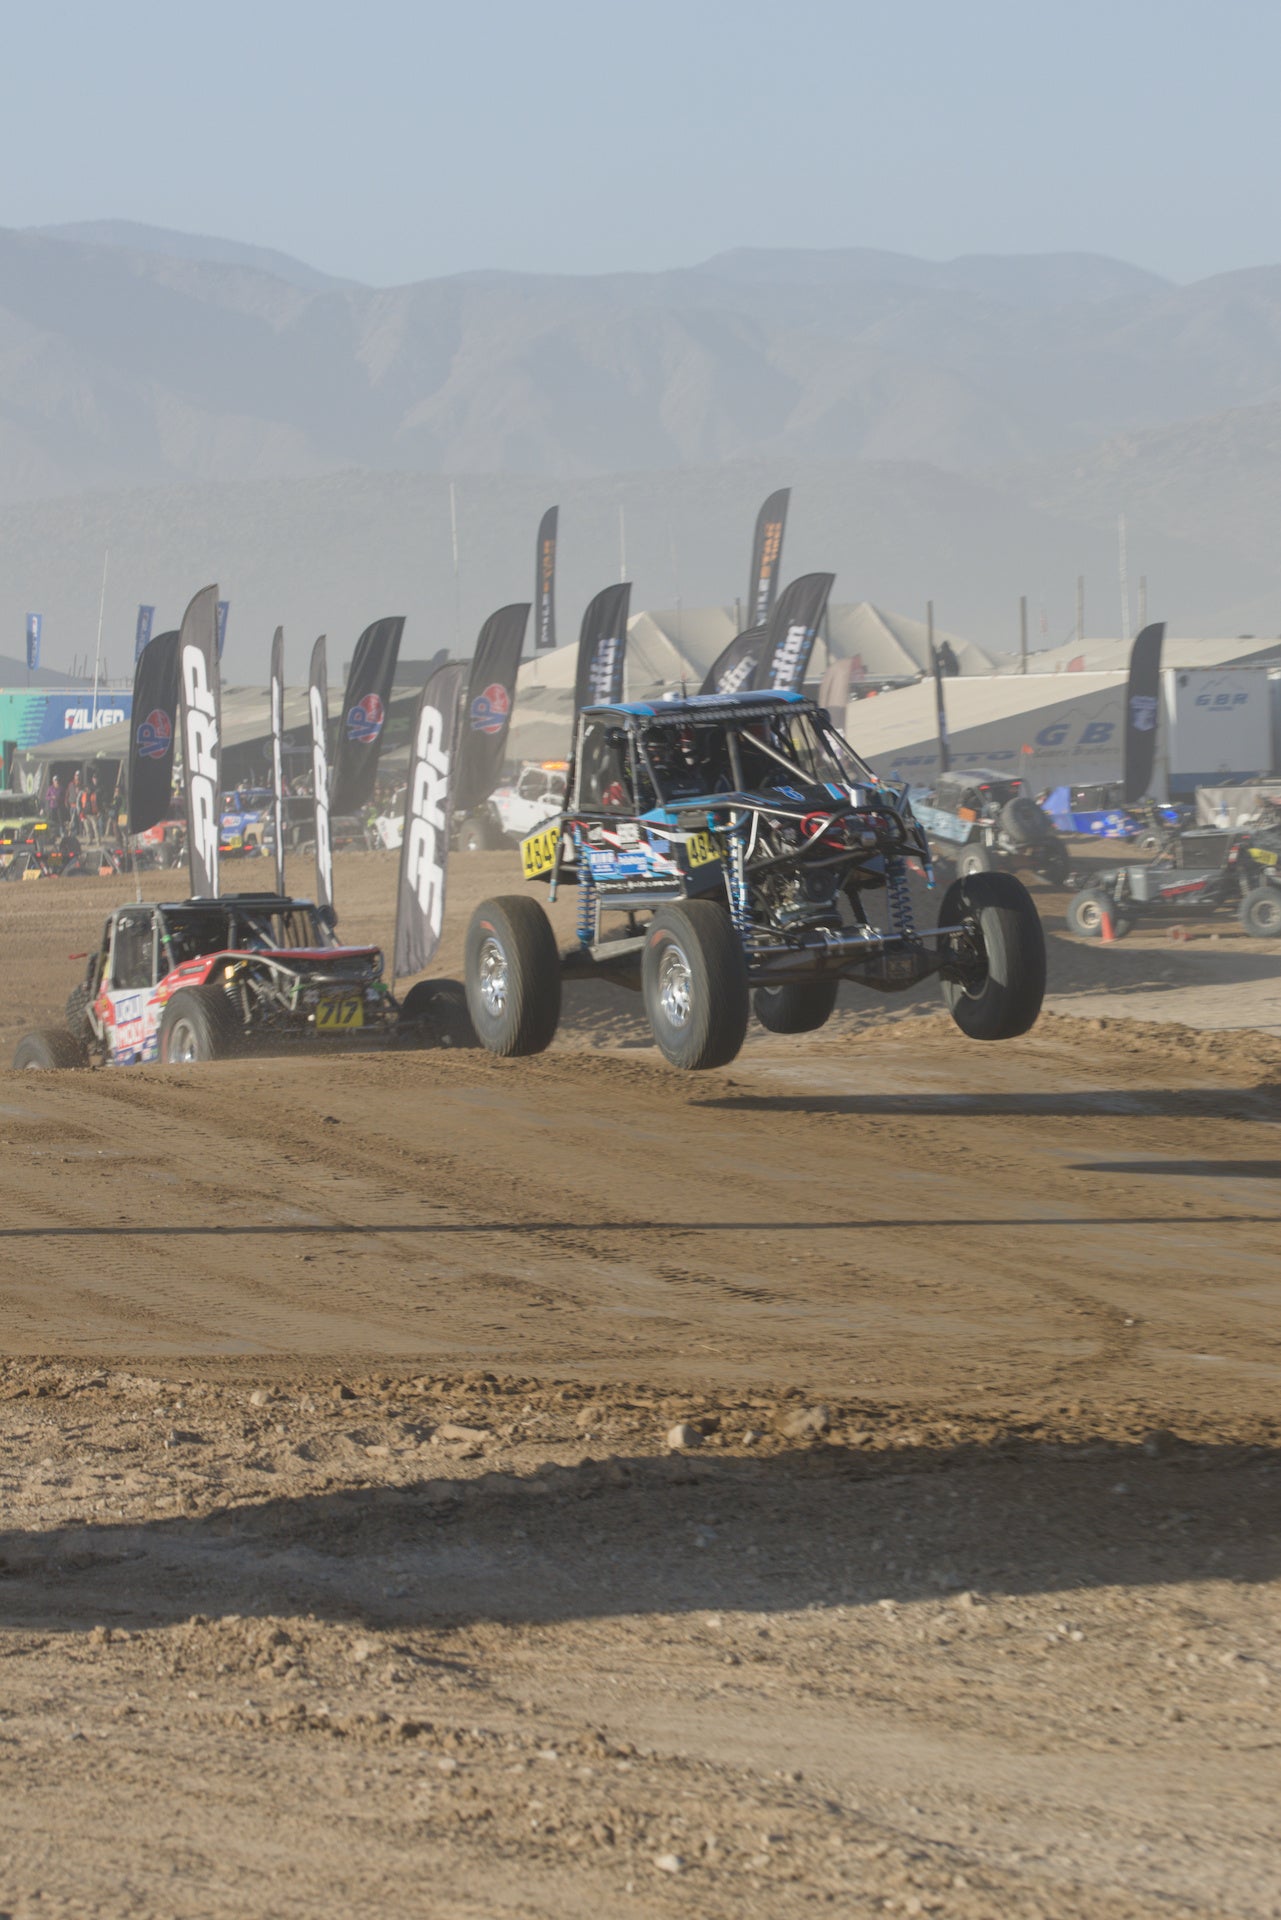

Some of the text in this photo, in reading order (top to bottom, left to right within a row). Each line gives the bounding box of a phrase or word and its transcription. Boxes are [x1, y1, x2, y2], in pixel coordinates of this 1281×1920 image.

[589, 637, 616, 705] riffin
[768, 626, 807, 691] riffin
[1194, 693, 1249, 707] GBR
[1035, 722, 1116, 747] GB
[407, 705, 450, 938] PRP
[691, 835, 722, 861] 484
[320, 1001, 358, 1025] 717
